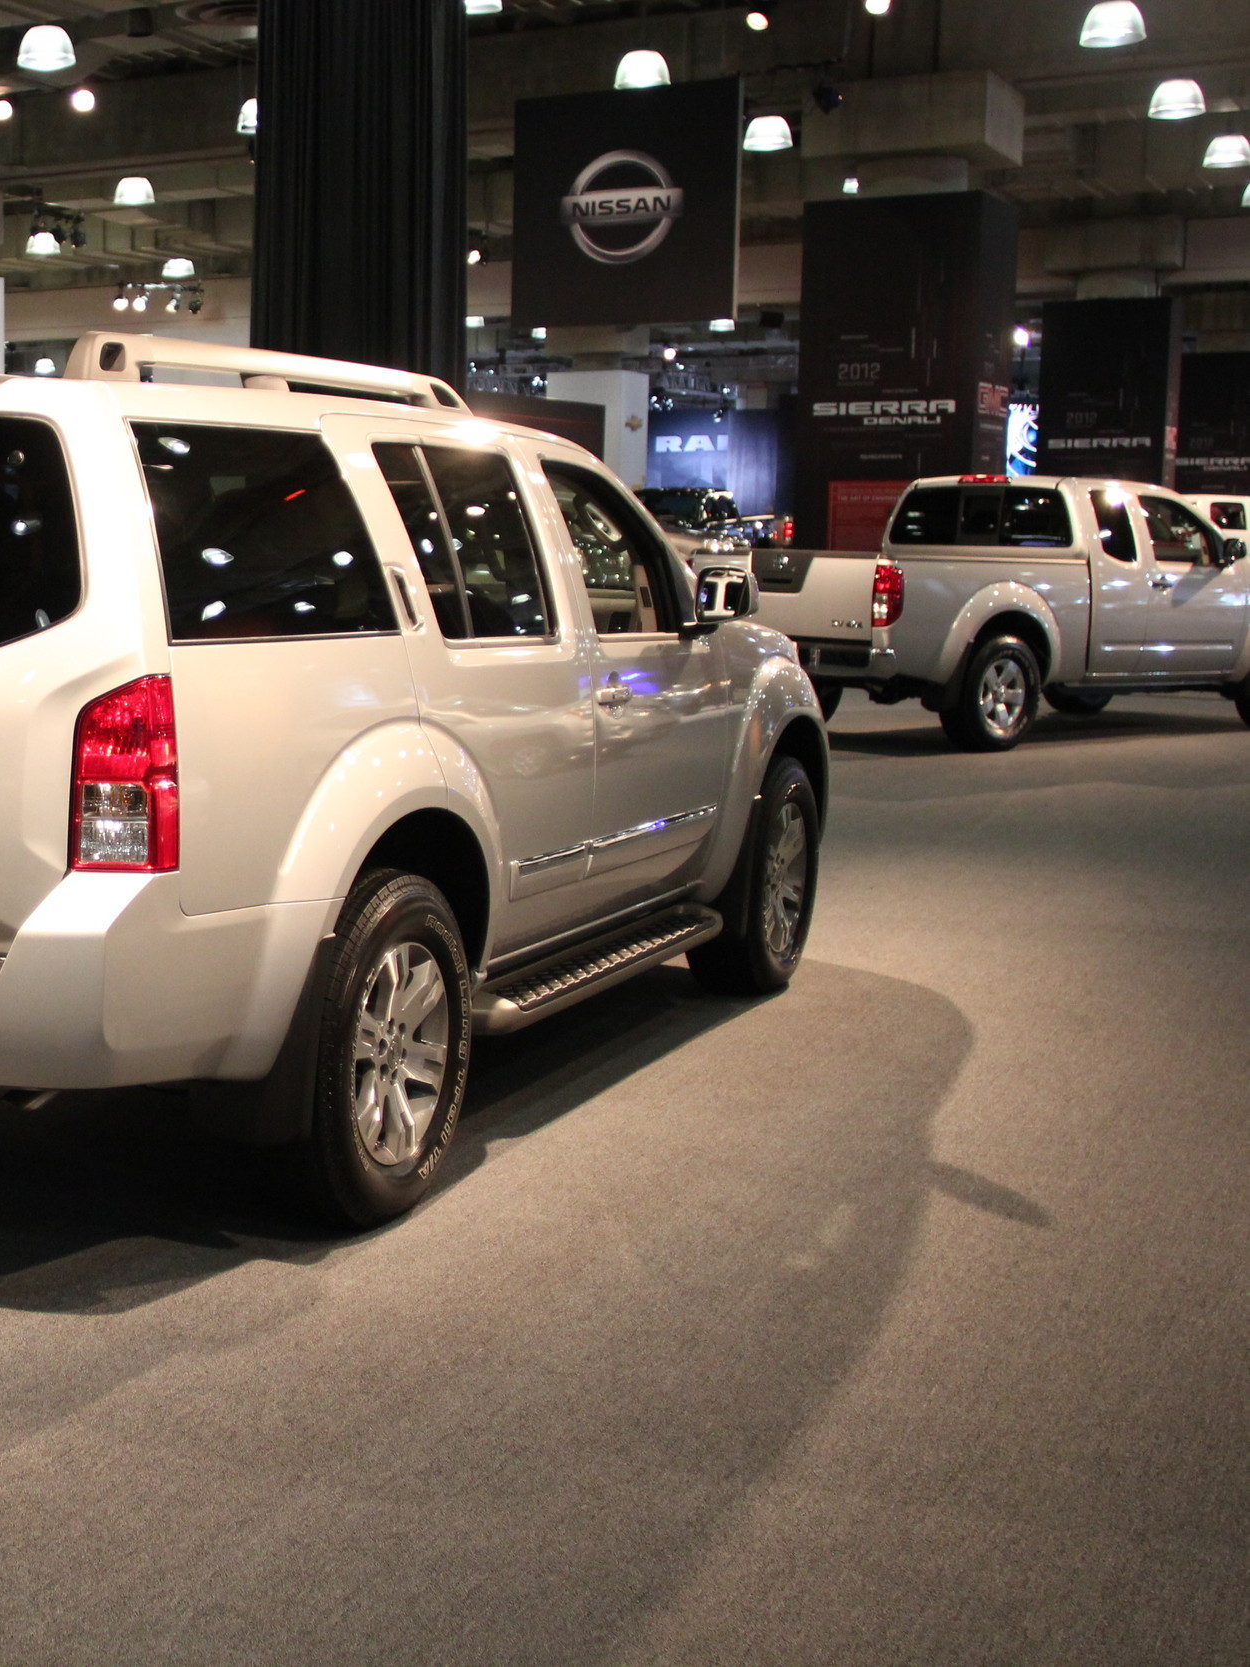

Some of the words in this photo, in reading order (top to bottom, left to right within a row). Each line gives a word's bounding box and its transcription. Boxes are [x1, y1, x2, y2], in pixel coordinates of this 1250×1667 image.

[571, 194, 671, 217] NISSAN
[838, 362, 882, 381] 2012
[812, 399, 957, 416] SIERRA
[863, 415, 942, 426] DENALI
[1048, 436, 1152, 449] SIERRA
